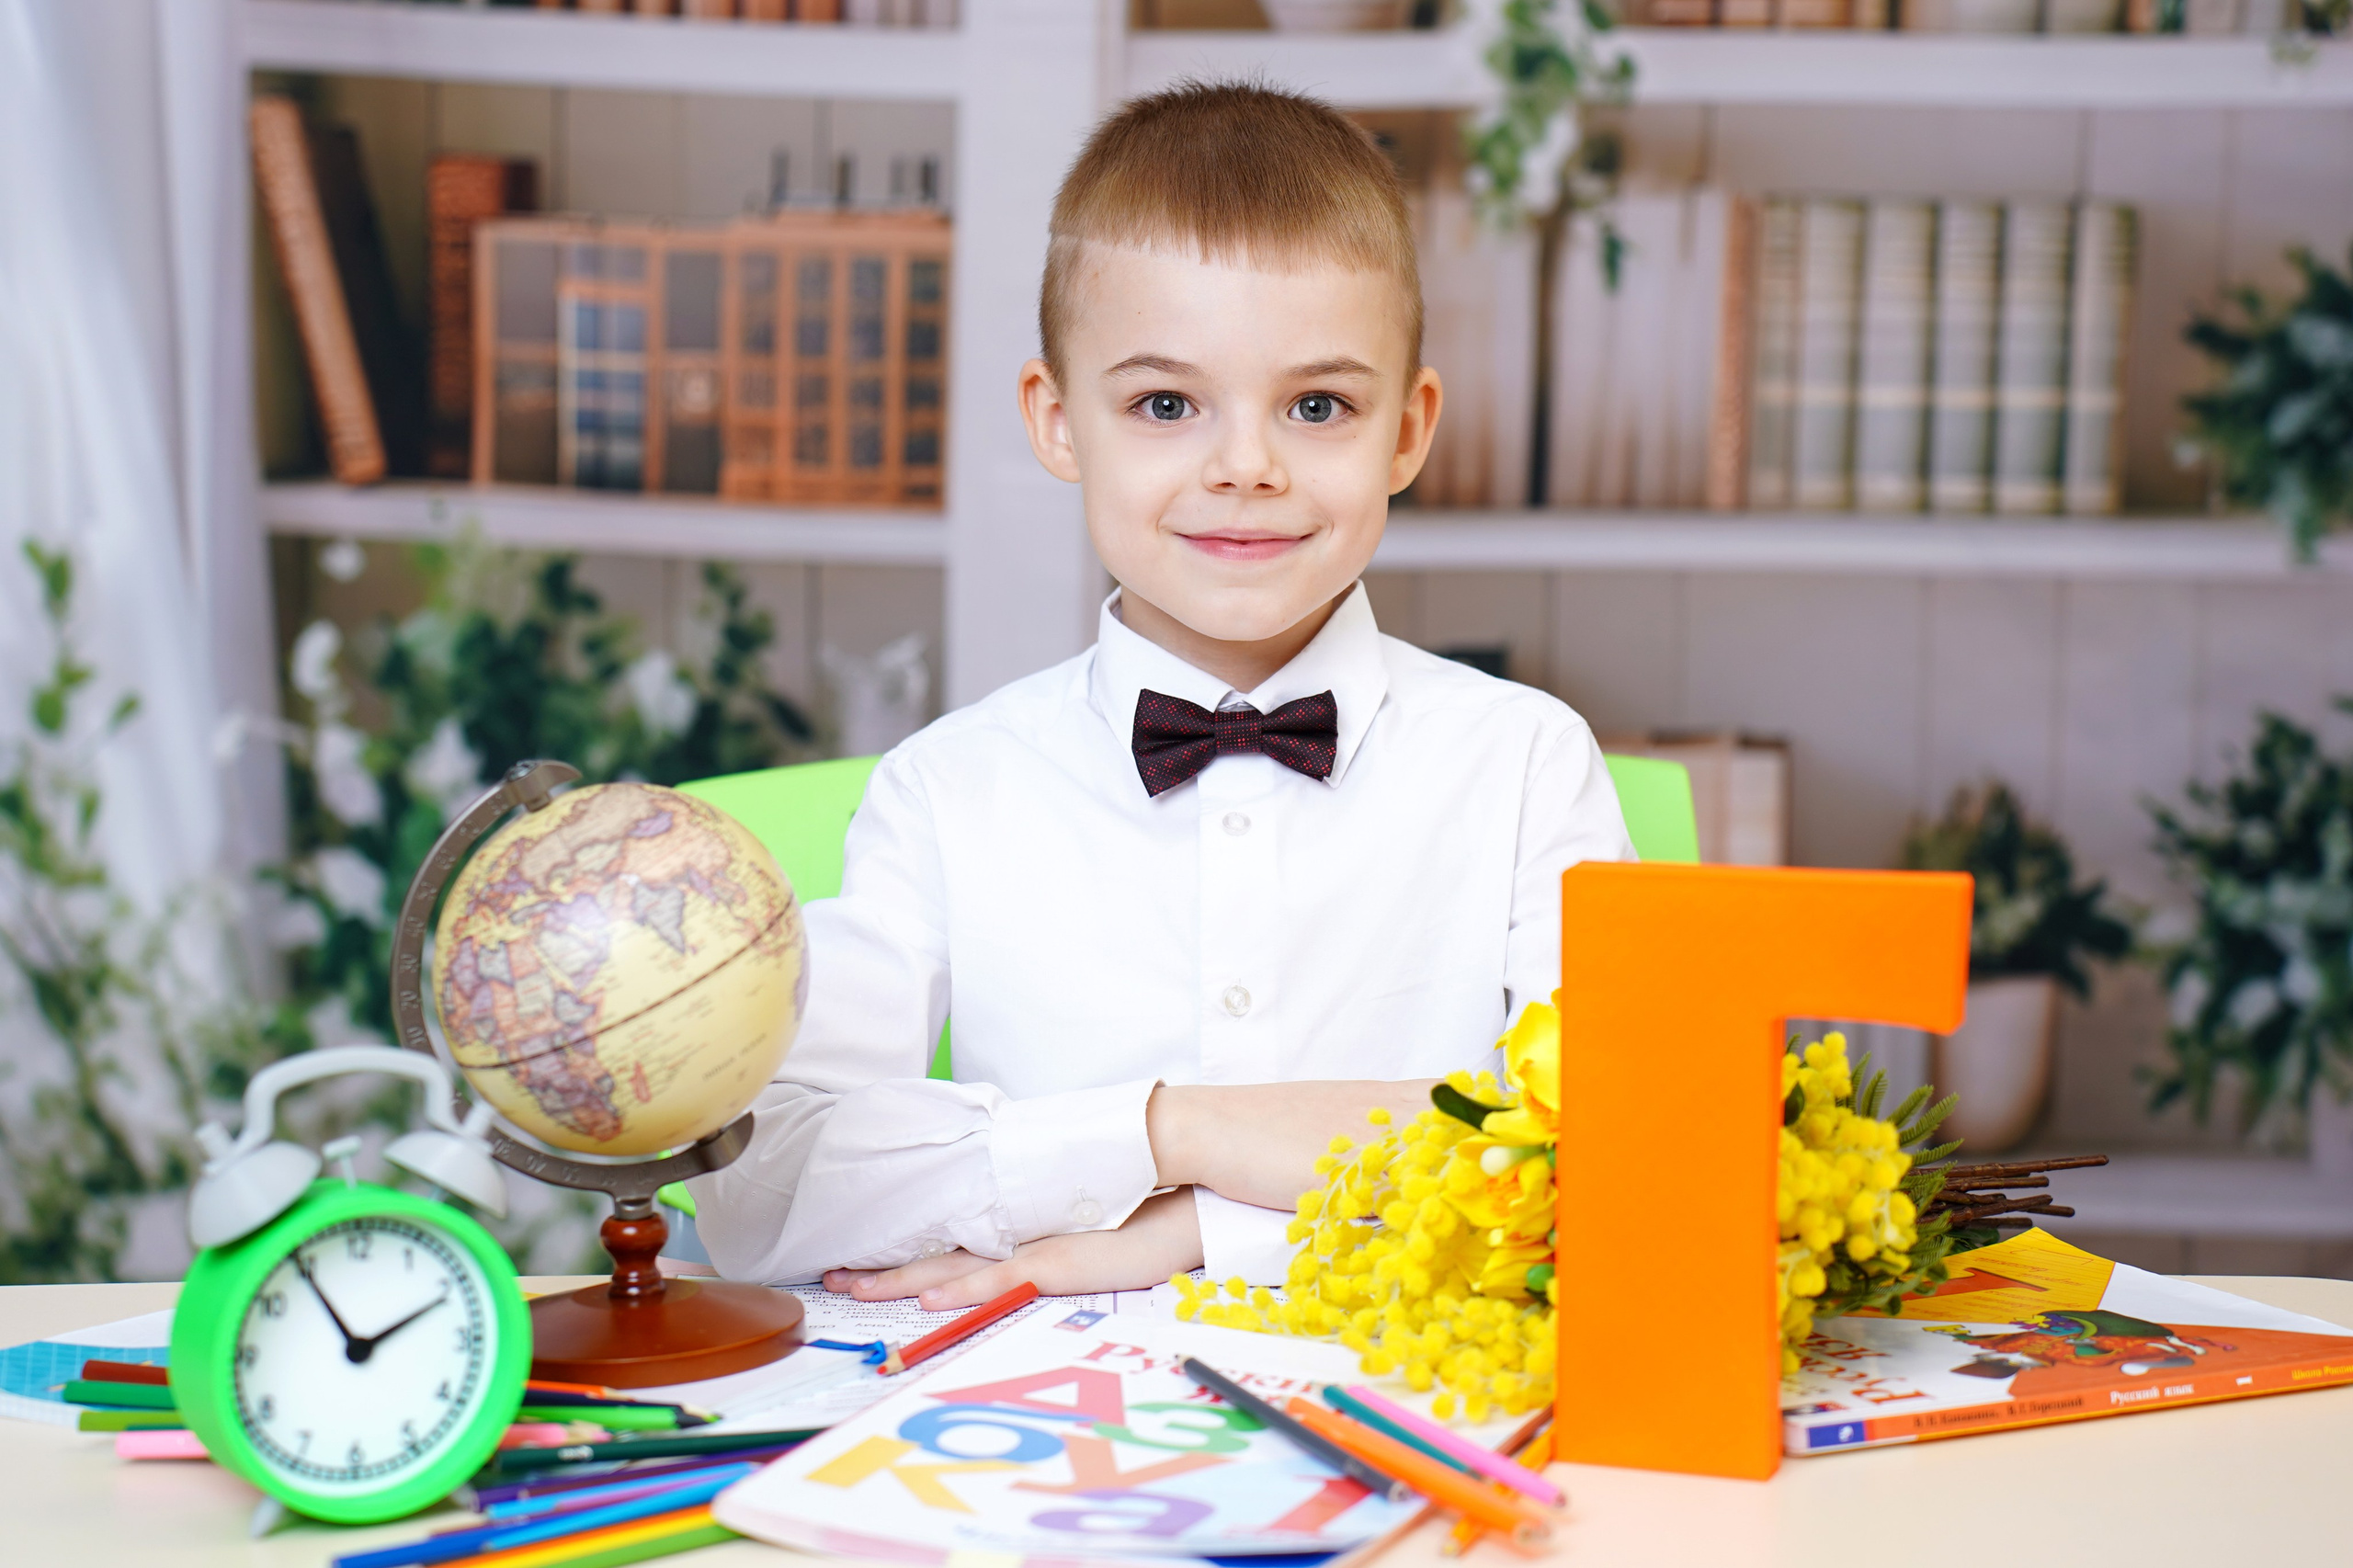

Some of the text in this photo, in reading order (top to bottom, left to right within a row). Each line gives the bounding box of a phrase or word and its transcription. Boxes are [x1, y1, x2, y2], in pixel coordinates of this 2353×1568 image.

[346, 1233, 374, 1261] 12
[258, 1290, 288, 1318] 10
[453, 1327, 472, 1353] 3
[434, 1379, 451, 1403] 4
[2110, 1386, 2160, 1406] Русский
[2165, 1383, 2195, 1397] язык
[258, 1394, 276, 1421] 8
[295, 1428, 314, 1457] 7
[400, 1418, 419, 1446] 5
[347, 1438, 364, 1466] 6
